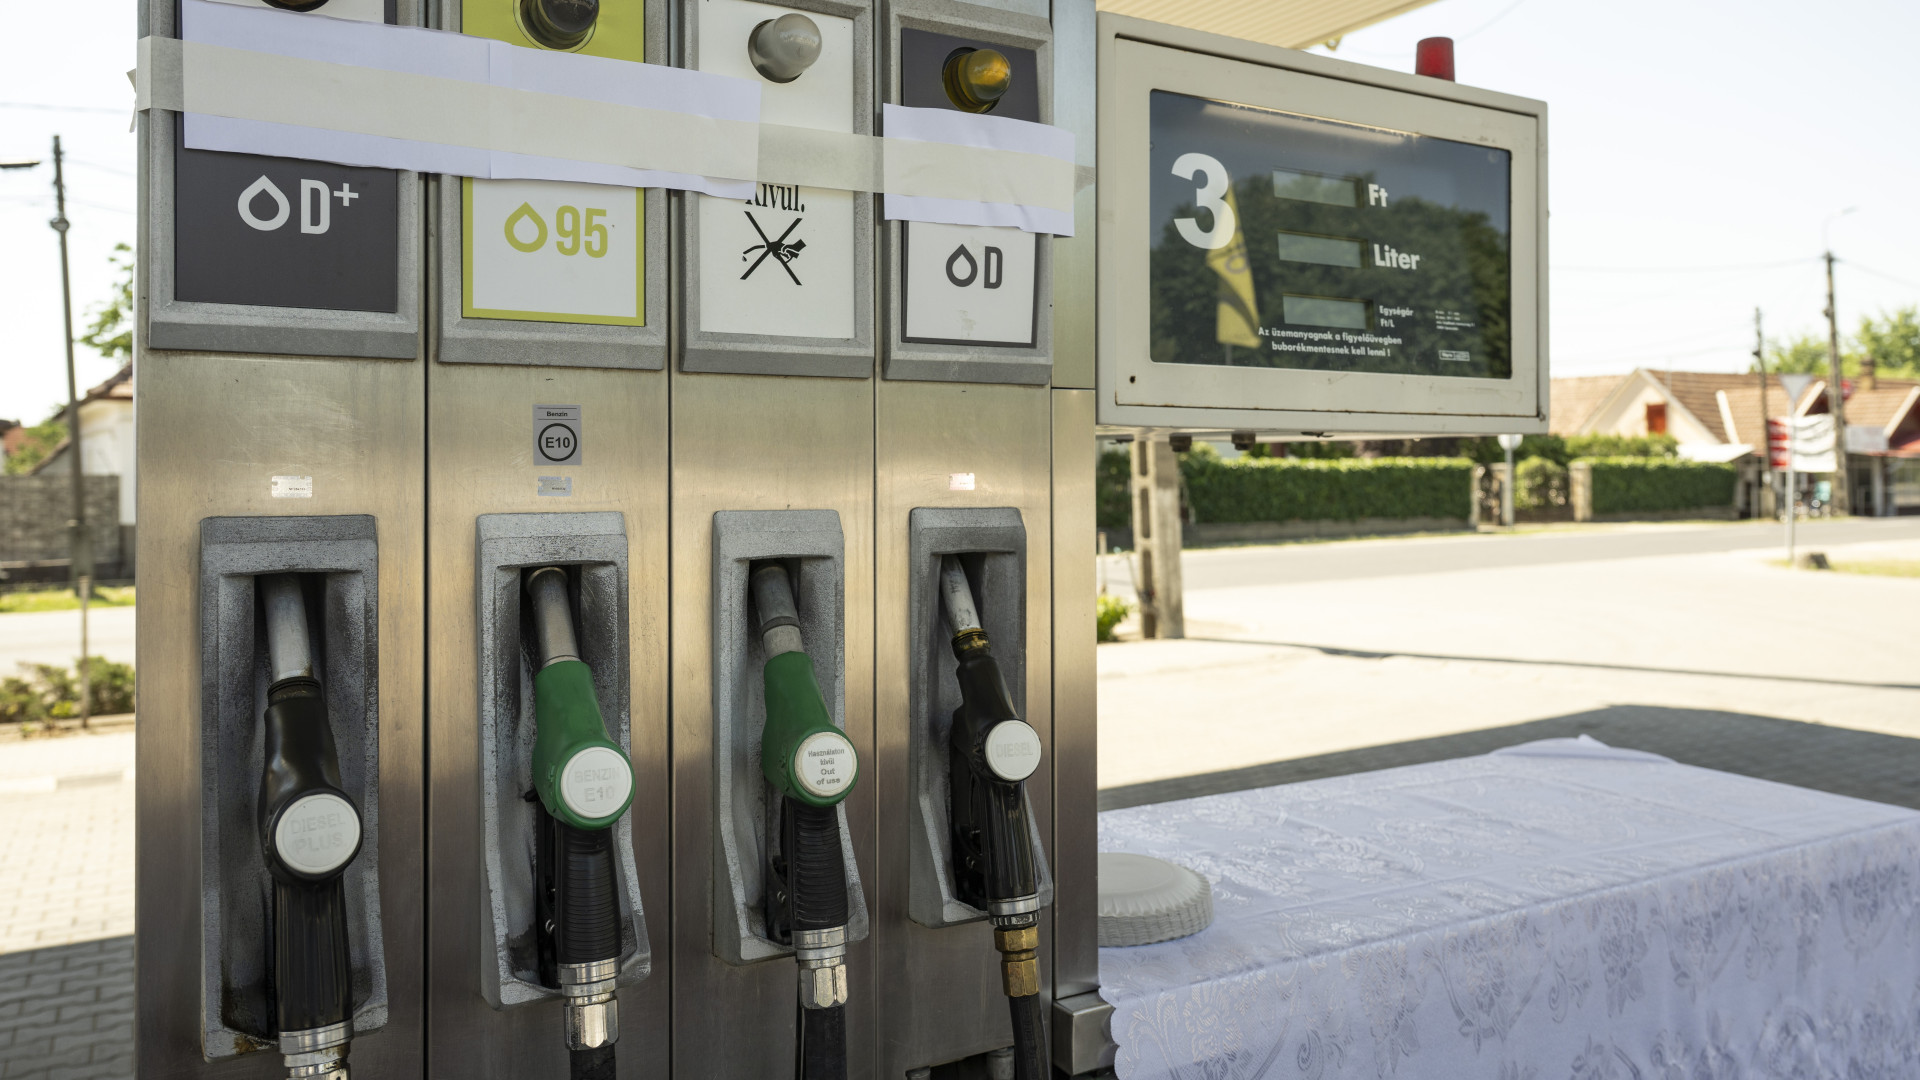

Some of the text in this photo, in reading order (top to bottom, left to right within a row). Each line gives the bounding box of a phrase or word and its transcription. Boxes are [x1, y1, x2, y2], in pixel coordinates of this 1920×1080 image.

[1171, 152, 1236, 250] 3
[1368, 183, 1388, 208] Ft
[300, 178, 359, 235] D+
[555, 204, 609, 258] 95
[1373, 243, 1420, 271] Liter
[984, 246, 1003, 289] D
[1379, 305, 1414, 318] Egységár
[1258, 326, 1270, 336] Az
[1271, 327, 1333, 342] üzemanyagnak
[1271, 341, 1350, 355] buborékmentesnek
[1351, 346, 1366, 356] kell
[545, 437, 571, 448] E10
[574, 766, 621, 784] BENZIN
[820, 767, 836, 776] Out
[816, 777, 841, 786] of use
[583, 785, 616, 803] E10
[290, 812, 347, 836] DIESEL
